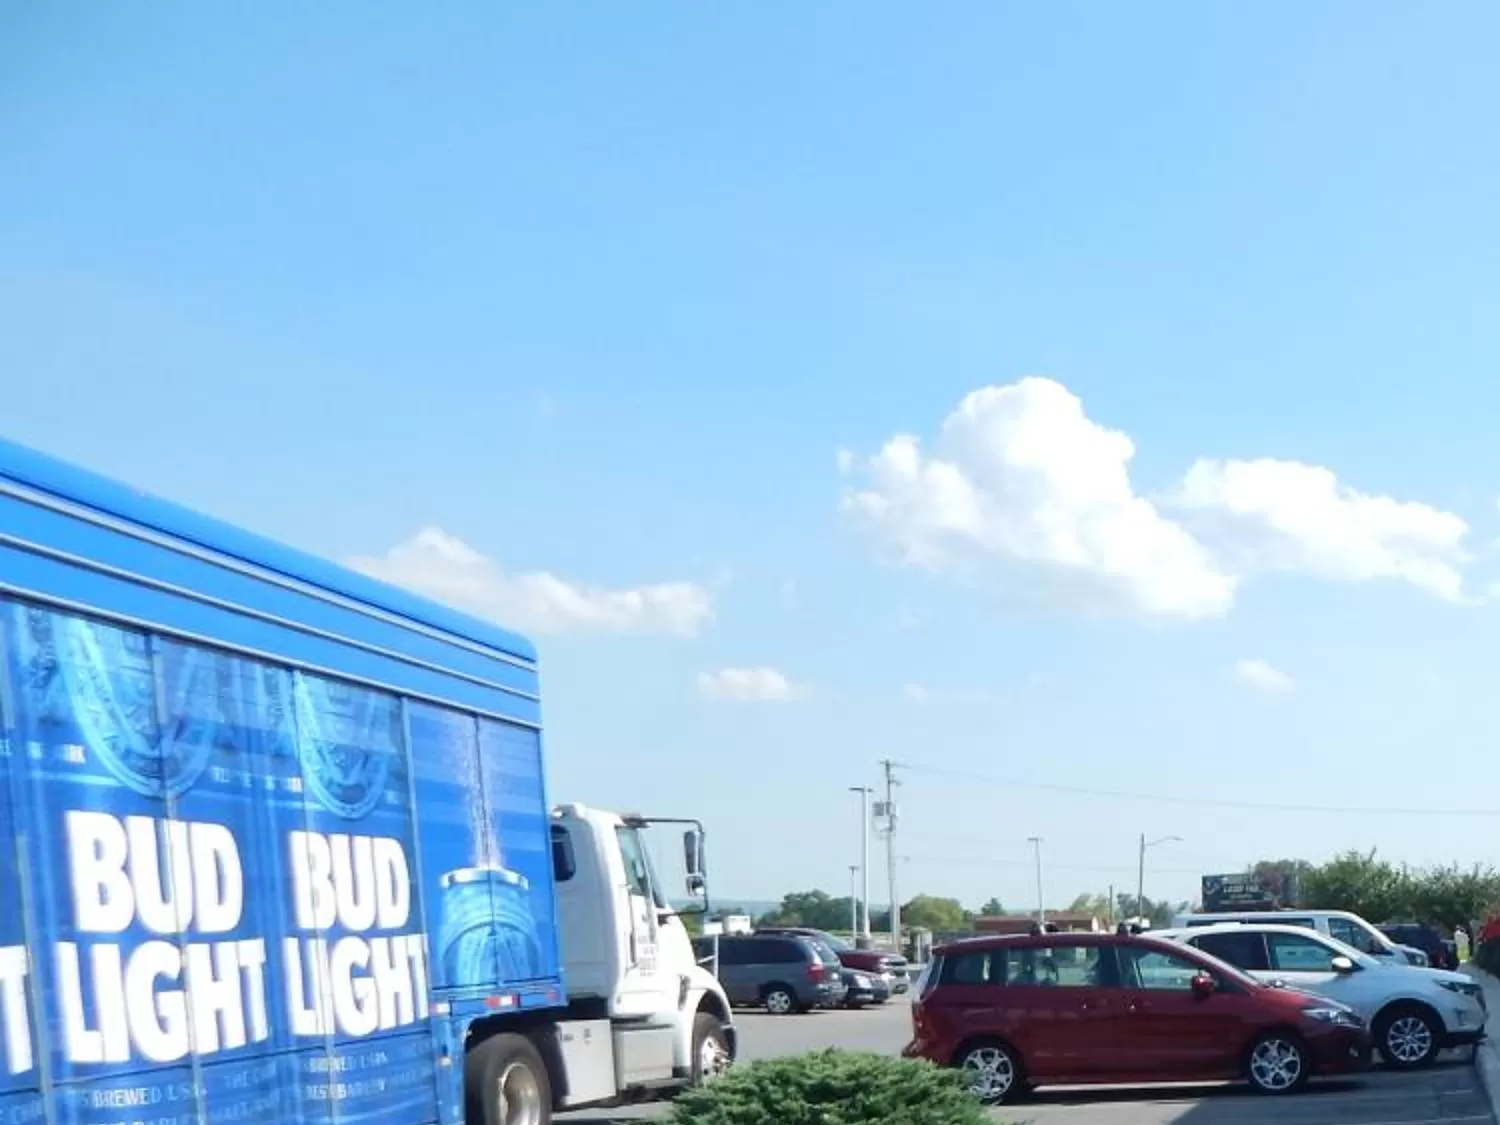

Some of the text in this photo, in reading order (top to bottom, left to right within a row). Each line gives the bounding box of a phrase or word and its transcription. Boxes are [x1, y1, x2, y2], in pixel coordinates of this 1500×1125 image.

[66, 811, 244, 934] BUD
[289, 830, 411, 930] BUD
[55, 937, 270, 1065] LIGHT
[283, 933, 431, 1037] LIGHT
[92, 1085, 163, 1108] BREWED
